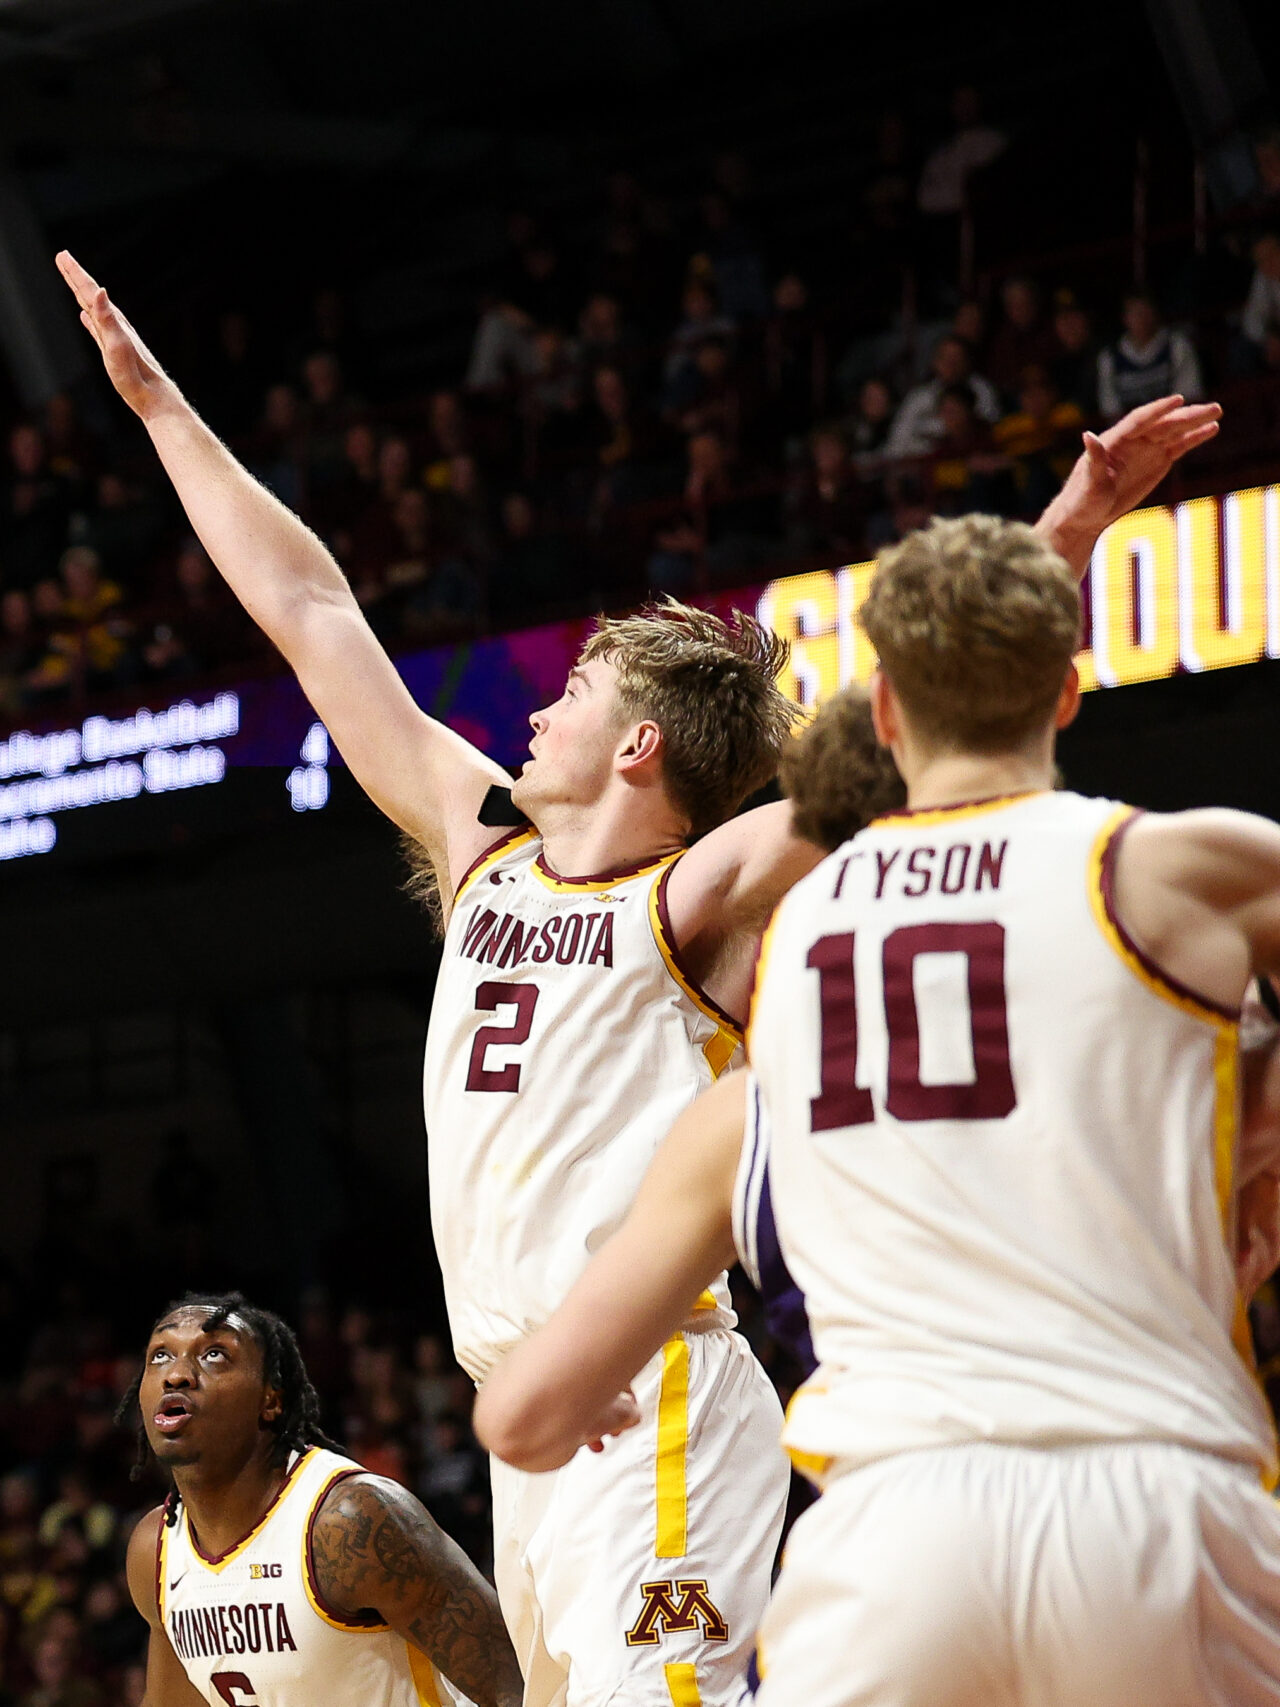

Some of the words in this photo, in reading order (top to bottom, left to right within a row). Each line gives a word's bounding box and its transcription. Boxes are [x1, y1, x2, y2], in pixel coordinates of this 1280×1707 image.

[830, 839, 1008, 900] TYSON
[465, 981, 540, 1093] 2
[806, 920, 1017, 1133] 10
[171, 1603, 298, 1659] MINNESOTA
[625, 1580, 728, 1647] M
